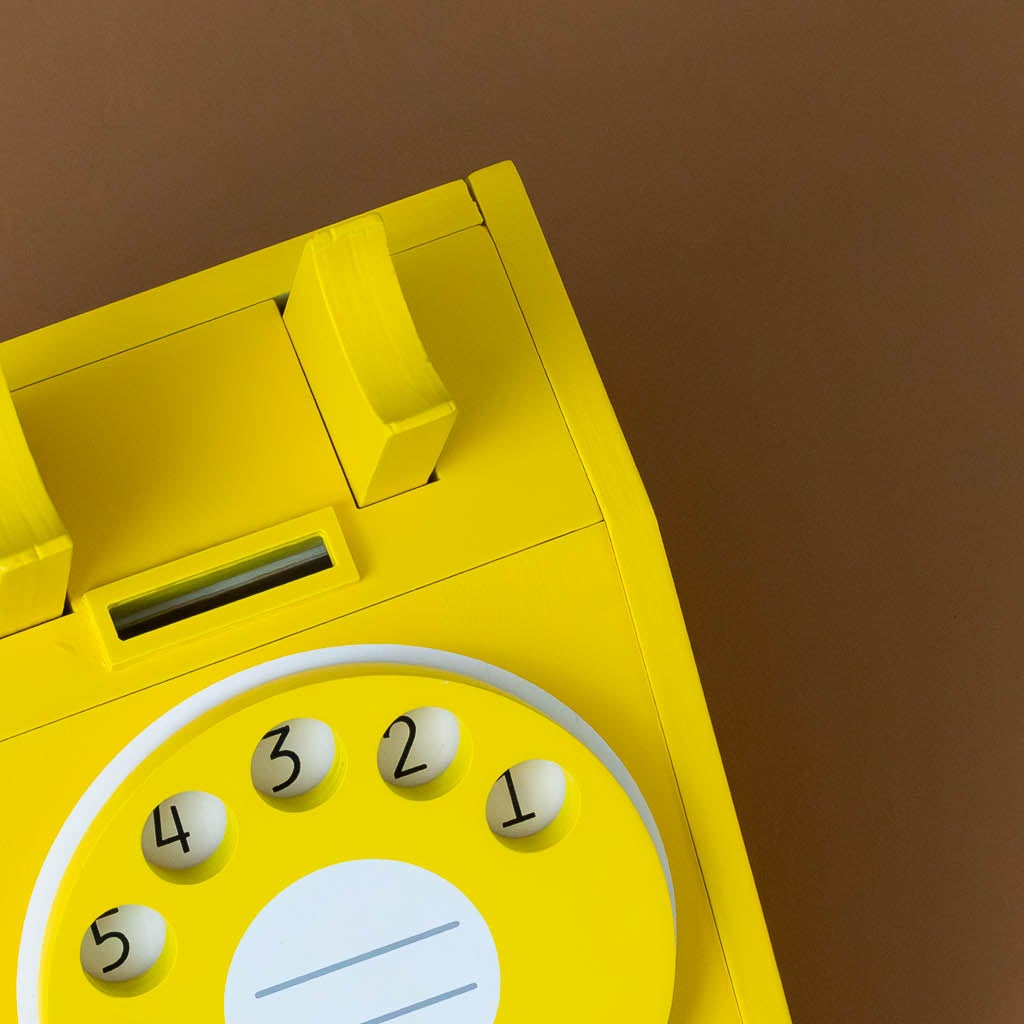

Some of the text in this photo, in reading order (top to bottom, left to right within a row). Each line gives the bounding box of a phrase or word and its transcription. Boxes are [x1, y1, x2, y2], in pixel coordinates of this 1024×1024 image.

[261, 724, 301, 793] 3
[382, 715, 428, 780] 2
[152, 805, 191, 854] 4
[497, 768, 536, 829] 1
[90, 907, 130, 974] 5
